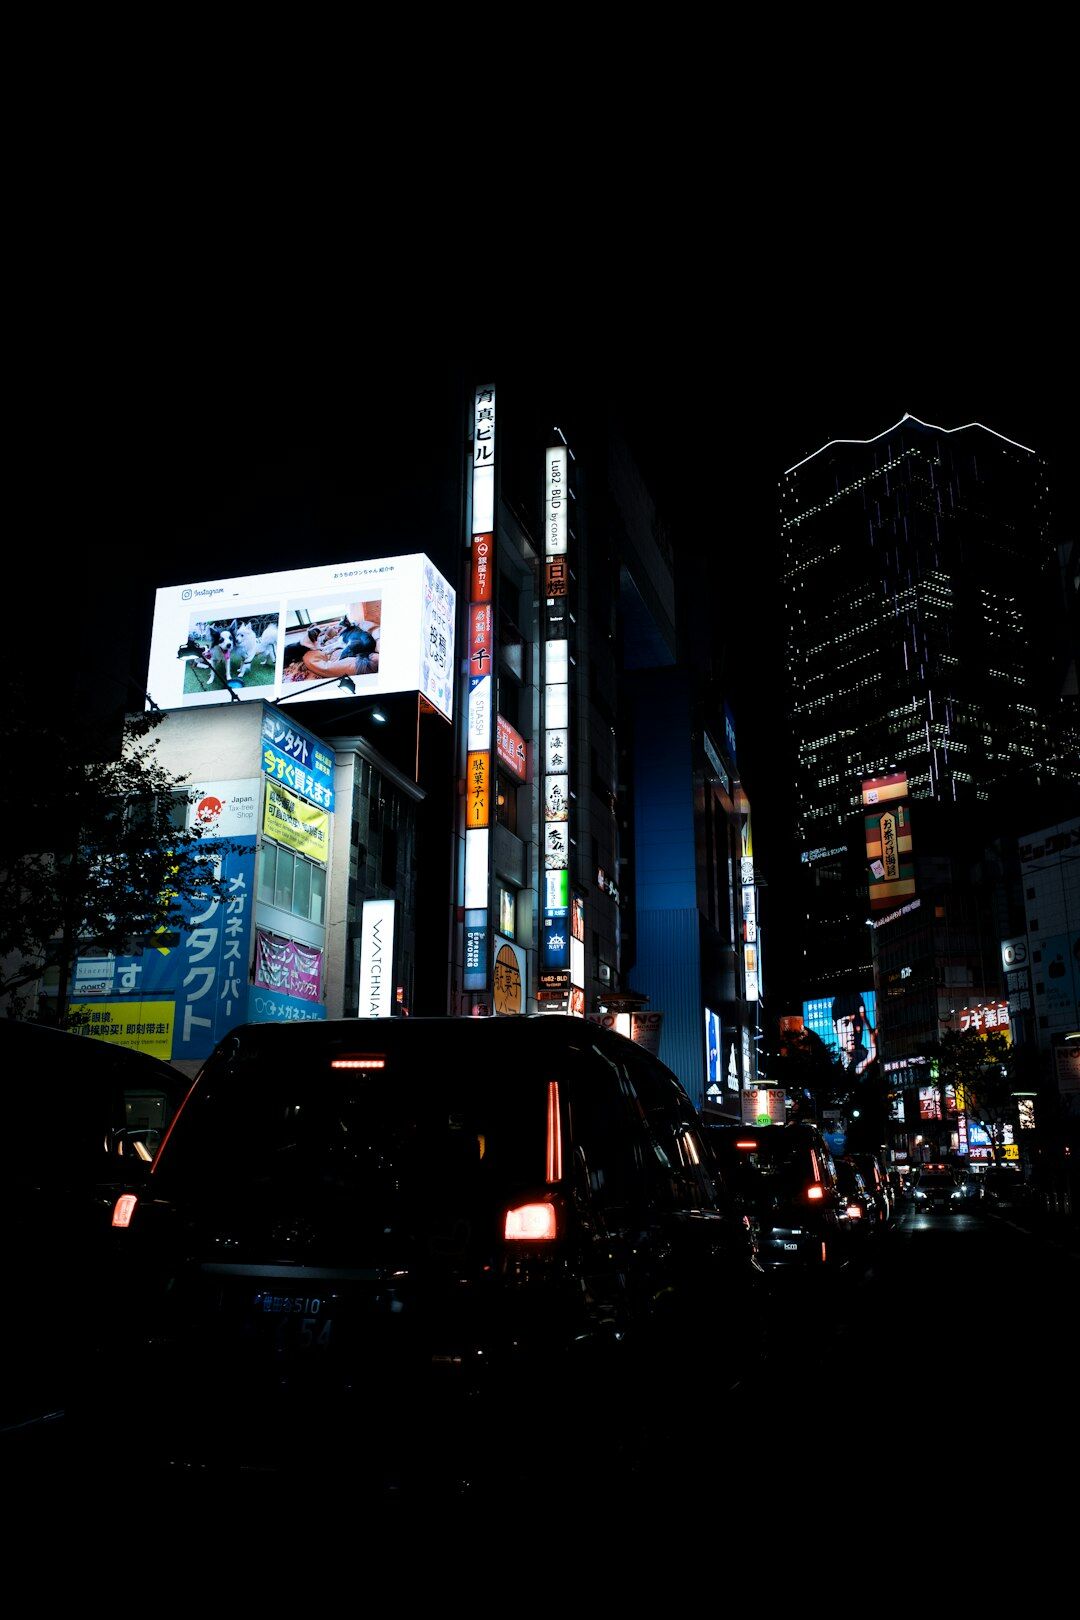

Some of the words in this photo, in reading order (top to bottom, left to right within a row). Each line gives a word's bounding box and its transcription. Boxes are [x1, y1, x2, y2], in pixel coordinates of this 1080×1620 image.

[193, 587, 224, 598] Instagram
[262, 717, 309, 763] コンタクト
[264, 750, 333, 808] 今すぐ買えます
[472, 759, 484, 820] 駄菓子バー
[228, 804, 254, 813] Tax-free
[237, 813, 254, 821] Shop
[221, 872, 248, 1016] メガネスーパー
[960, 1007, 1009, 1032] スギ薬局
